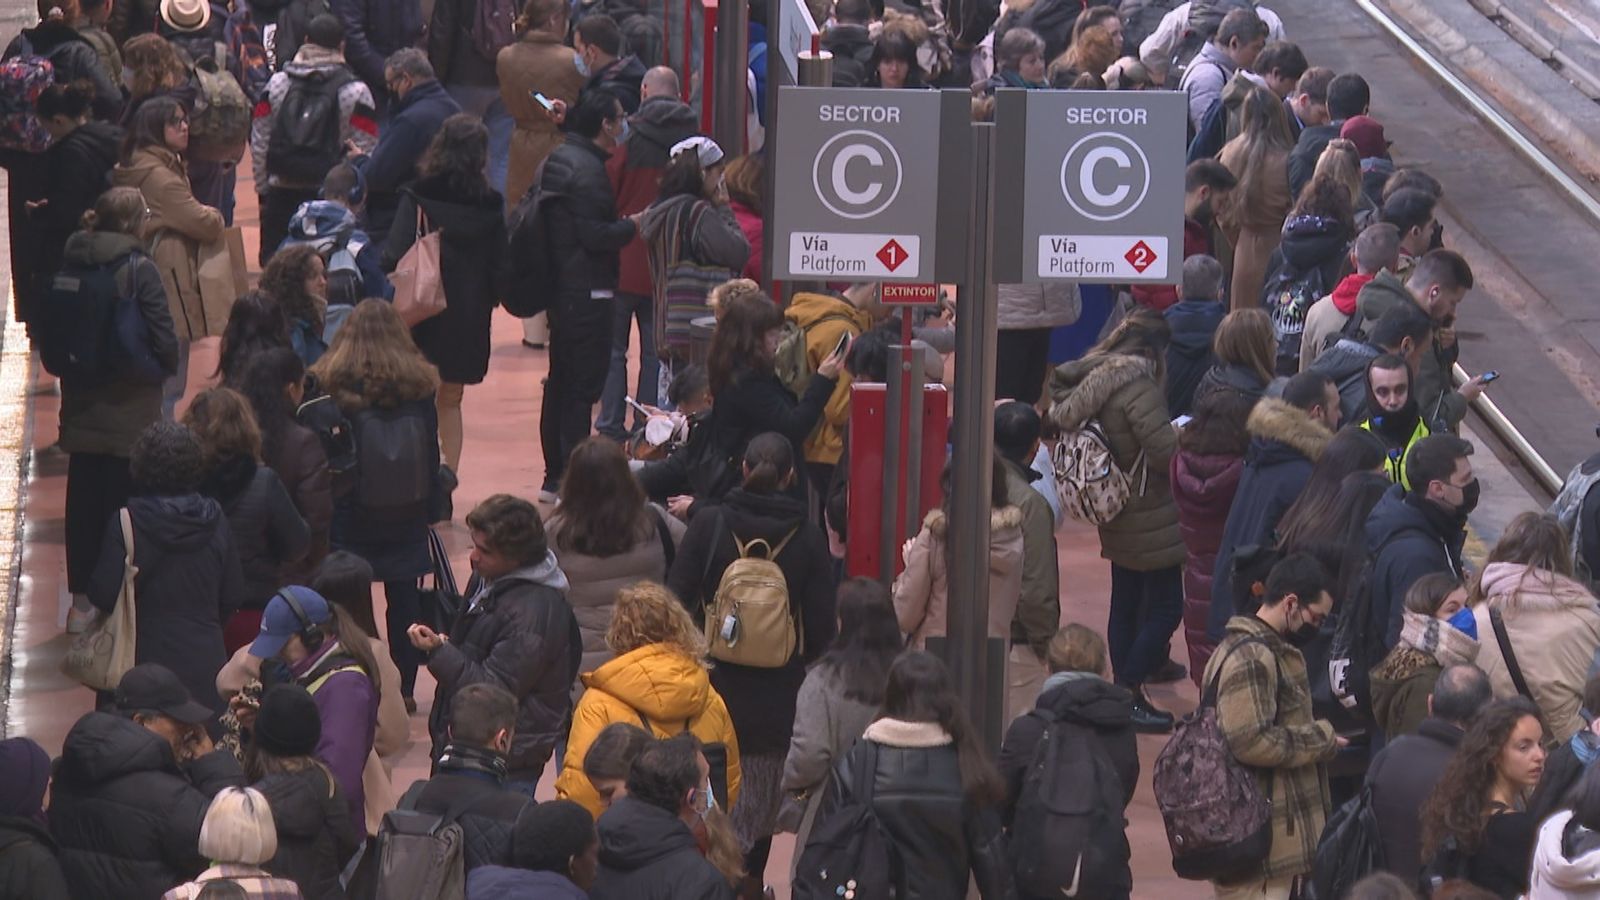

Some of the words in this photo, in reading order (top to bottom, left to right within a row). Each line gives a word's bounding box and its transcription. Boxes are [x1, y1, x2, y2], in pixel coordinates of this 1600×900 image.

[819, 104, 900, 123] SECTOR
[1066, 107, 1147, 125] SECTOR
[832, 143, 884, 205] C
[1079, 145, 1131, 207] C
[802, 235, 829, 251] Vía
[1050, 237, 1077, 254] Vía
[801, 254, 866, 274] Platform
[886, 245, 897, 265] 1
[1133, 247, 1148, 267] 2
[1049, 257, 1115, 276] Platform
[884, 286, 935, 297] EXTINTOR
